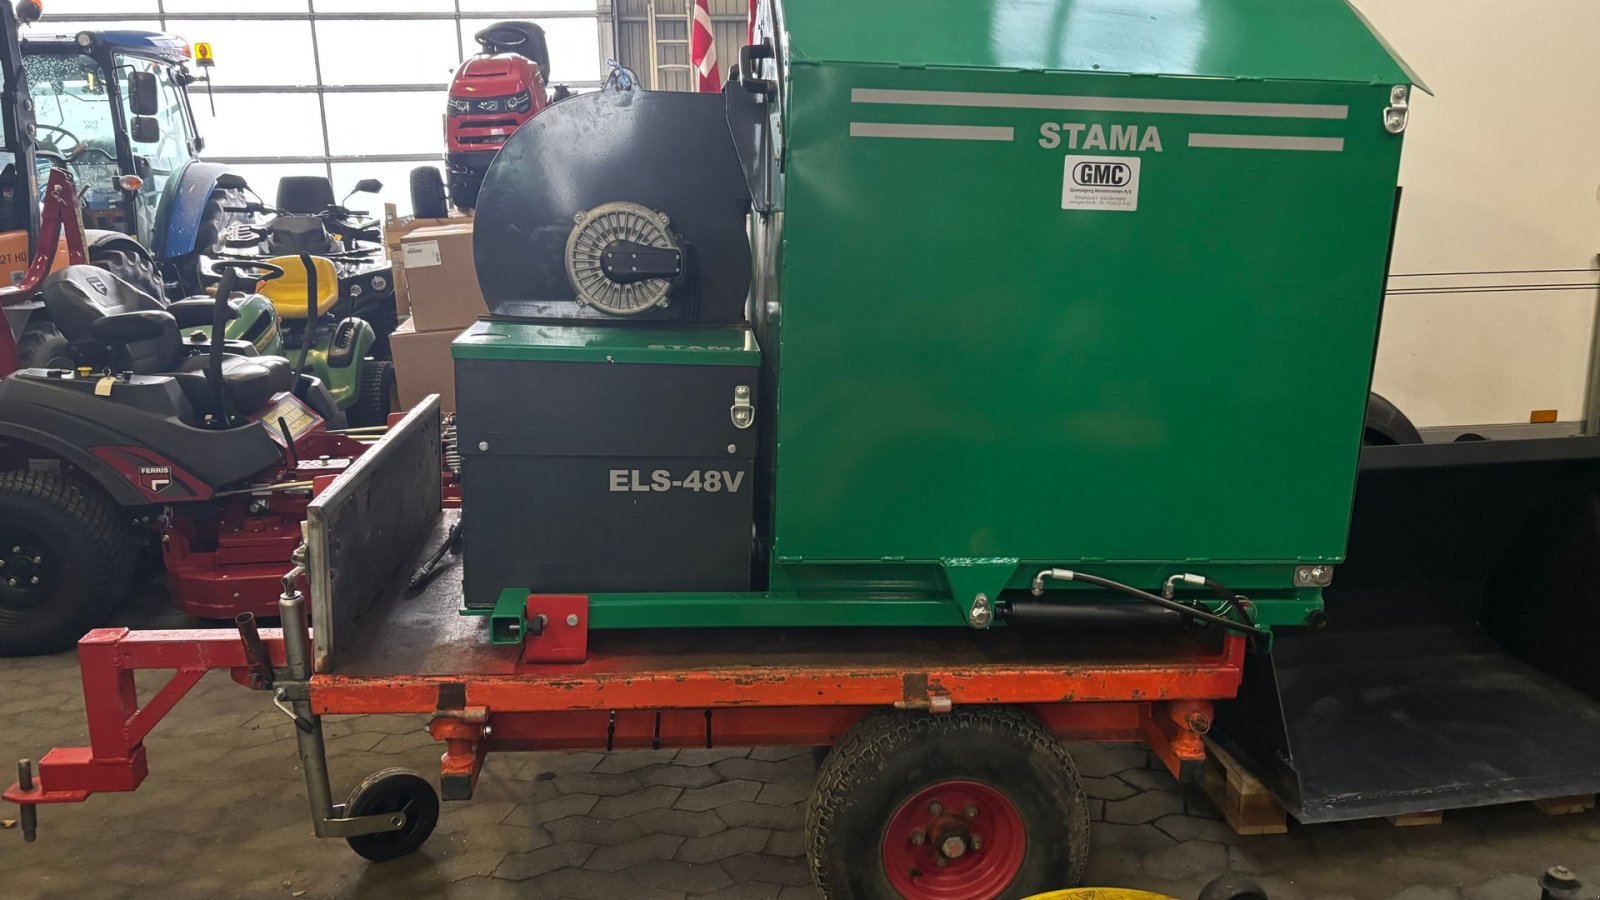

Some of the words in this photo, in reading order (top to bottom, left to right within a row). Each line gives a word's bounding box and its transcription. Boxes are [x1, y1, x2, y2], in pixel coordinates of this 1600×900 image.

[1039, 122, 1163, 152] STAMA
[1080, 164, 1123, 184] GMC
[609, 469, 745, 492] ELS-48V
